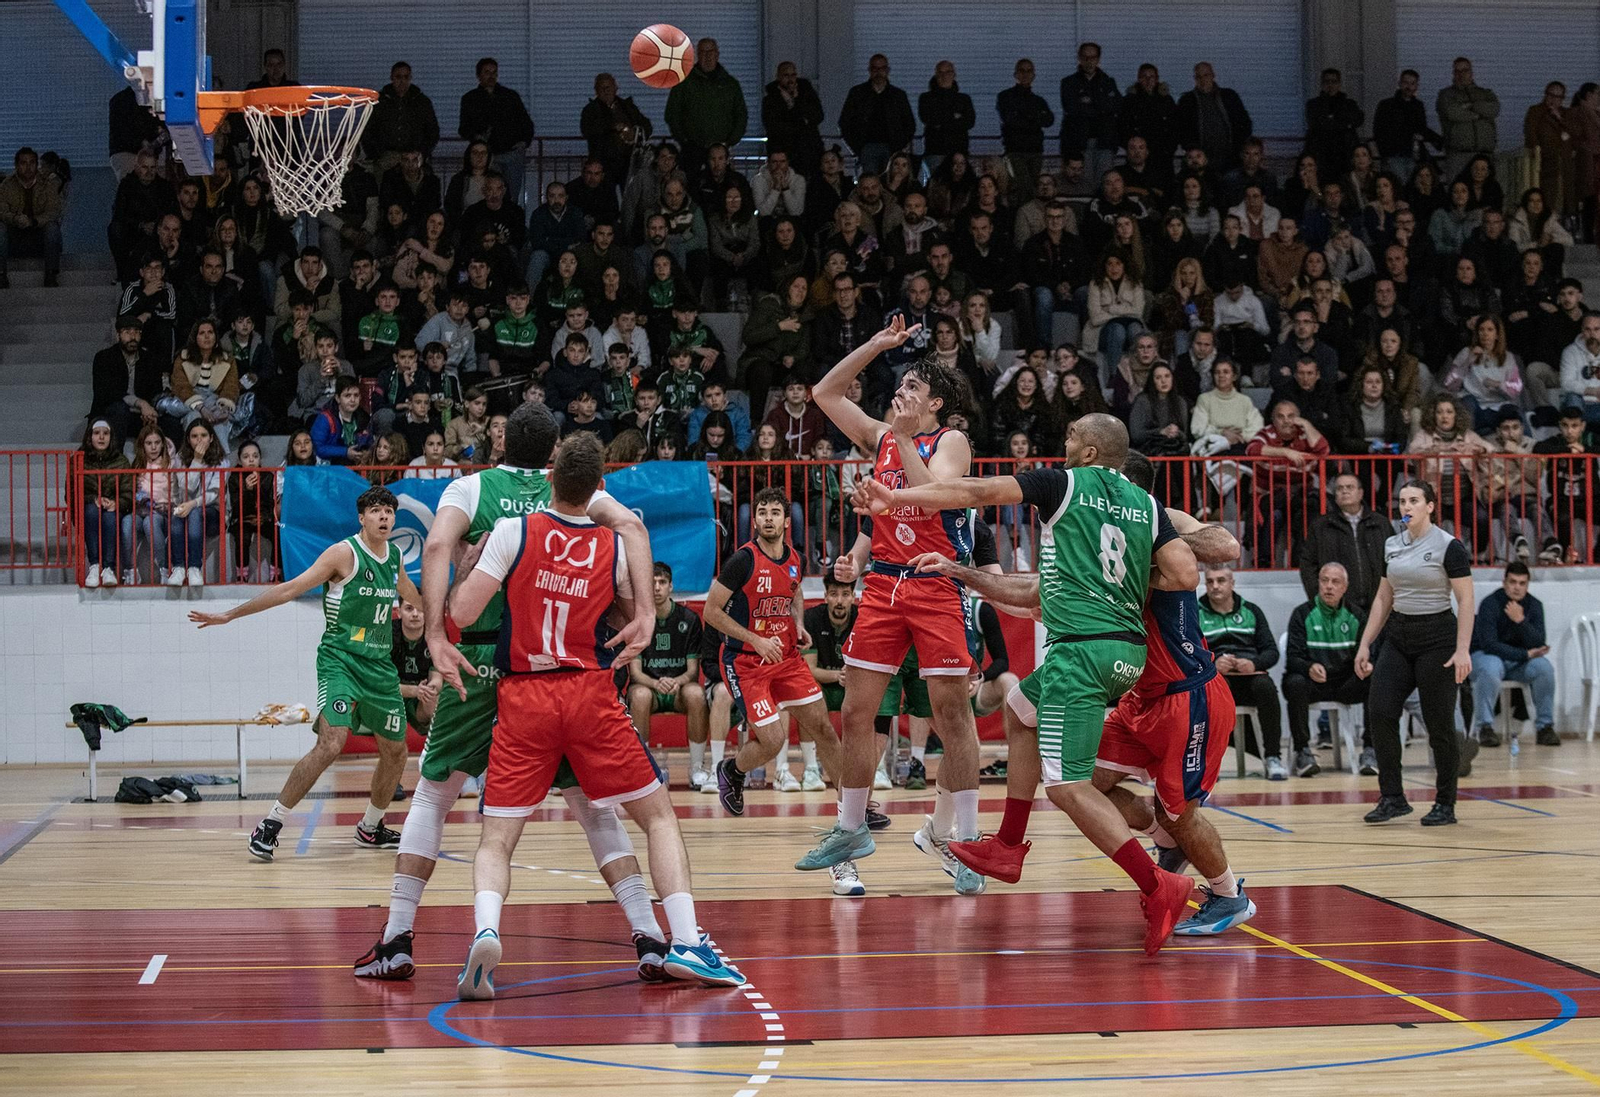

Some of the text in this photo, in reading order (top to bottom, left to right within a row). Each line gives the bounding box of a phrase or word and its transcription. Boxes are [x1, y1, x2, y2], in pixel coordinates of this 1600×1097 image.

[883, 446, 893, 466] 5
[1079, 492, 1149, 525] LLEVENES
[1098, 522, 1128, 589] 8
[358, 586, 373, 596] CB
[756, 576, 772, 593] 24
[372, 603, 390, 625] 14
[542, 597, 571, 658] 11
[655, 633, 671, 651] 19
[404, 656, 419, 674] 21
[477, 664, 505, 679] OK
[752, 698, 772, 718] 24
[384, 713, 401, 733] 19
